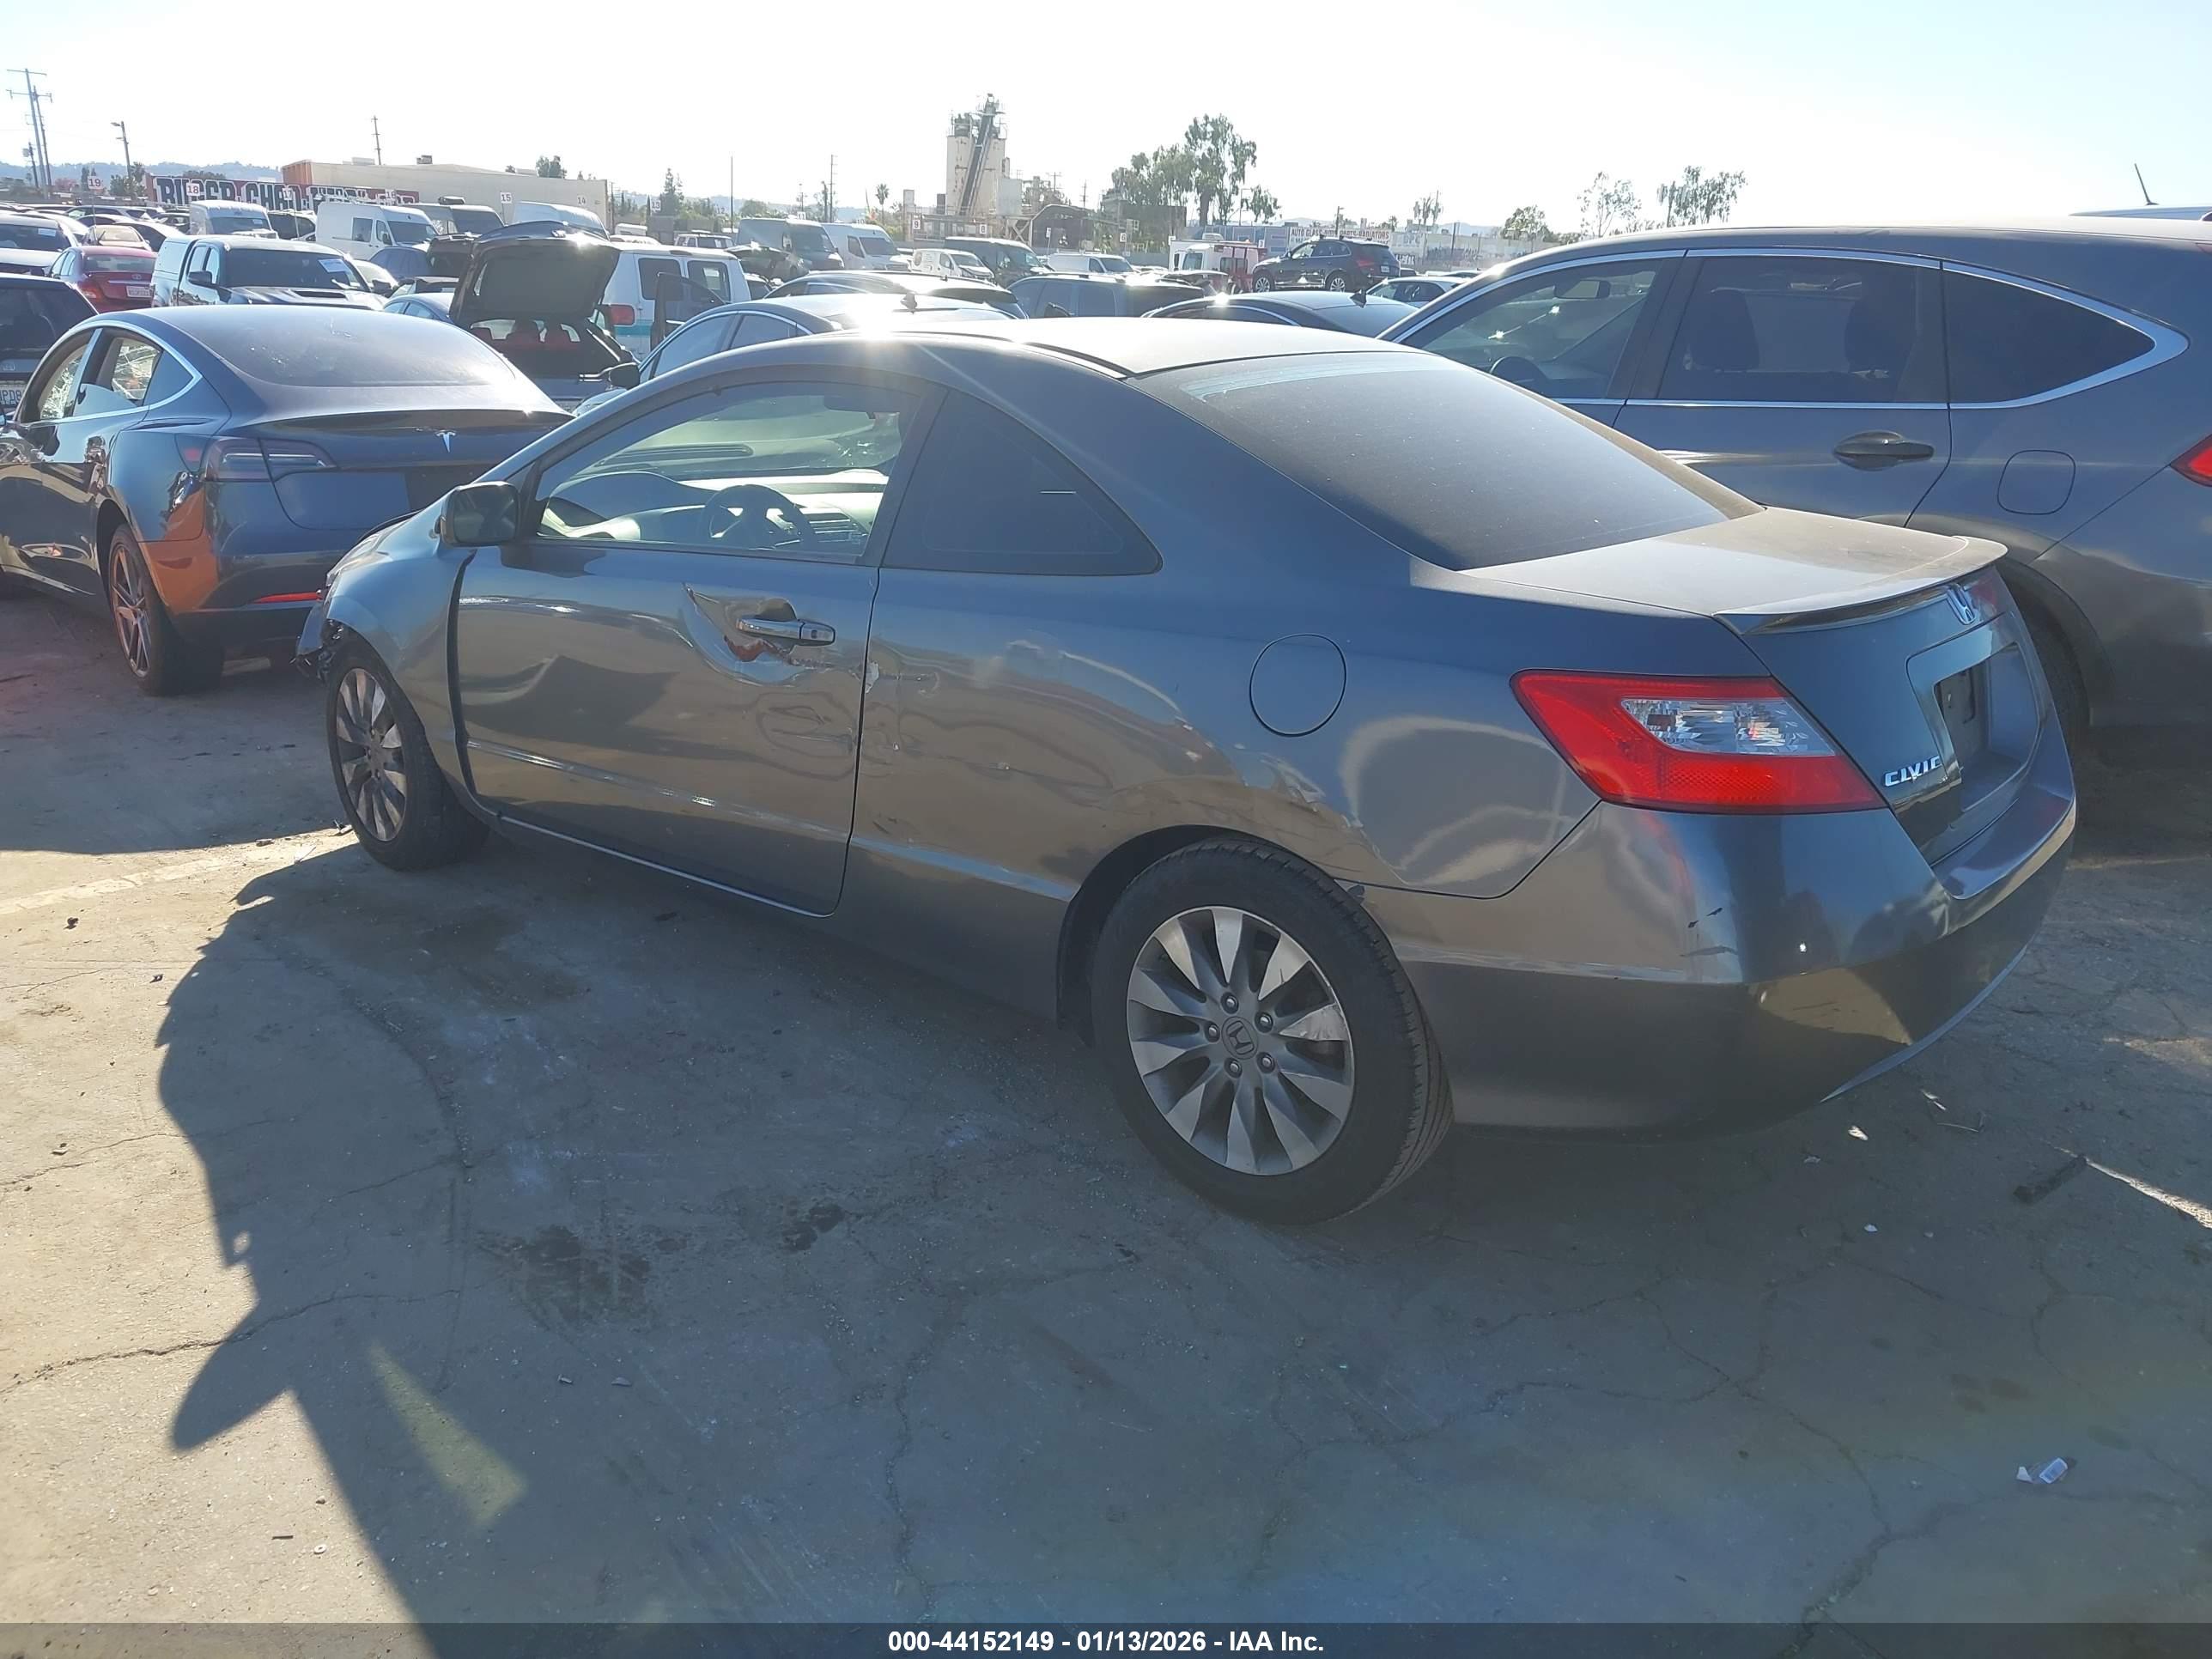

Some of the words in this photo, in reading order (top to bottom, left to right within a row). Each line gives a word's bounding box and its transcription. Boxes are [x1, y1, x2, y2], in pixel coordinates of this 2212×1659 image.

[89, 178, 101, 187] 19
[187, 185, 198, 194] 18
[1885, 755, 1942, 787] CIVIC
